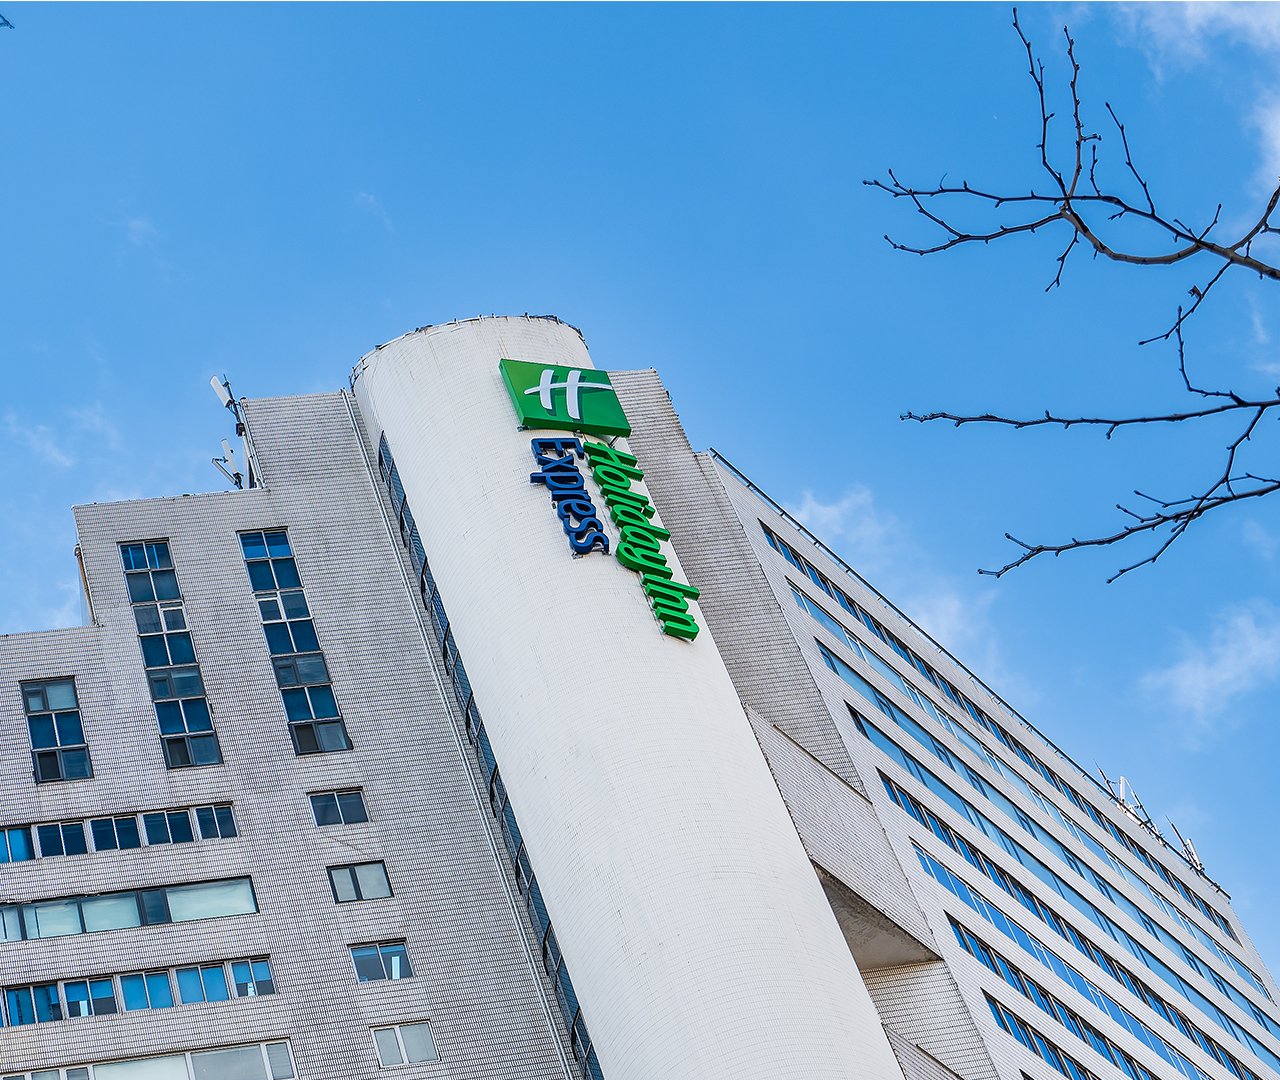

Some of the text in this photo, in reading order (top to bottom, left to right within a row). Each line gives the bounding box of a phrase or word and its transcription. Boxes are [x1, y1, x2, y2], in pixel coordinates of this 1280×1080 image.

[530, 437, 610, 555] Express
[583, 441, 701, 642] Holiday Inn
